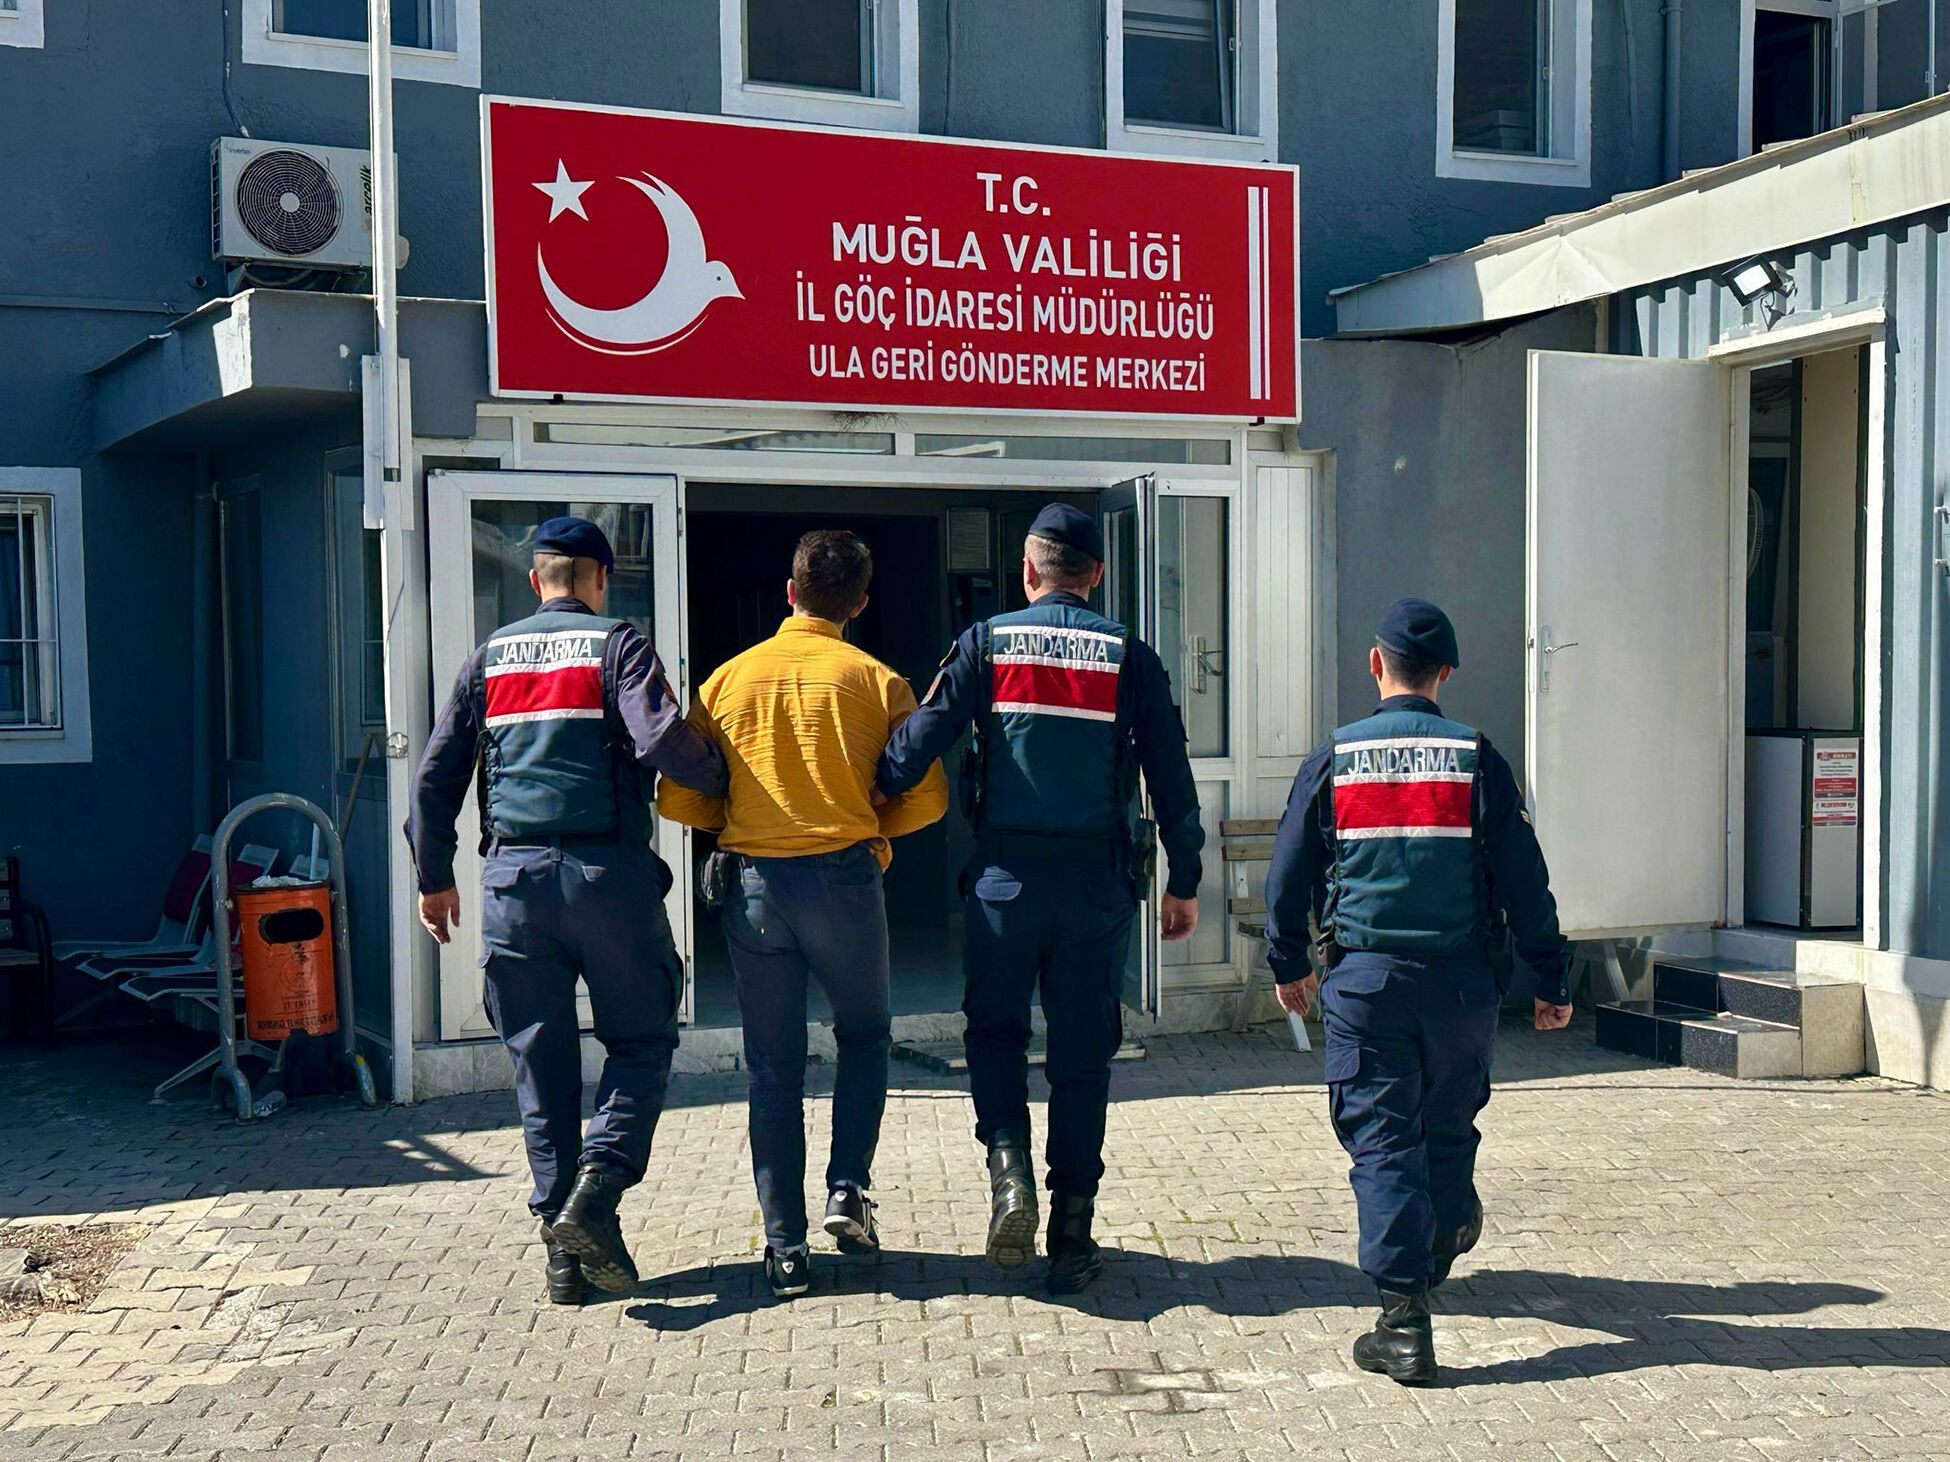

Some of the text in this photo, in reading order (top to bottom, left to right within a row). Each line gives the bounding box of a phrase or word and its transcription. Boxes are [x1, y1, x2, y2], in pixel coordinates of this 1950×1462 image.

[976, 172, 1051, 216] T.C.
[832, 215, 1181, 282] MUĞLA VALİLİĞİ
[796, 270, 1214, 340] İL GÖÇ İDARESİ MÜDÜRLÜĞÜ
[809, 340, 1205, 392] ULA GERİ GÖNDERME MERKEZİ
[496, 638, 592, 664] JANDARMA
[1003, 633, 1108, 662] JANDARMA
[1347, 747, 1461, 775] JANDARMA
